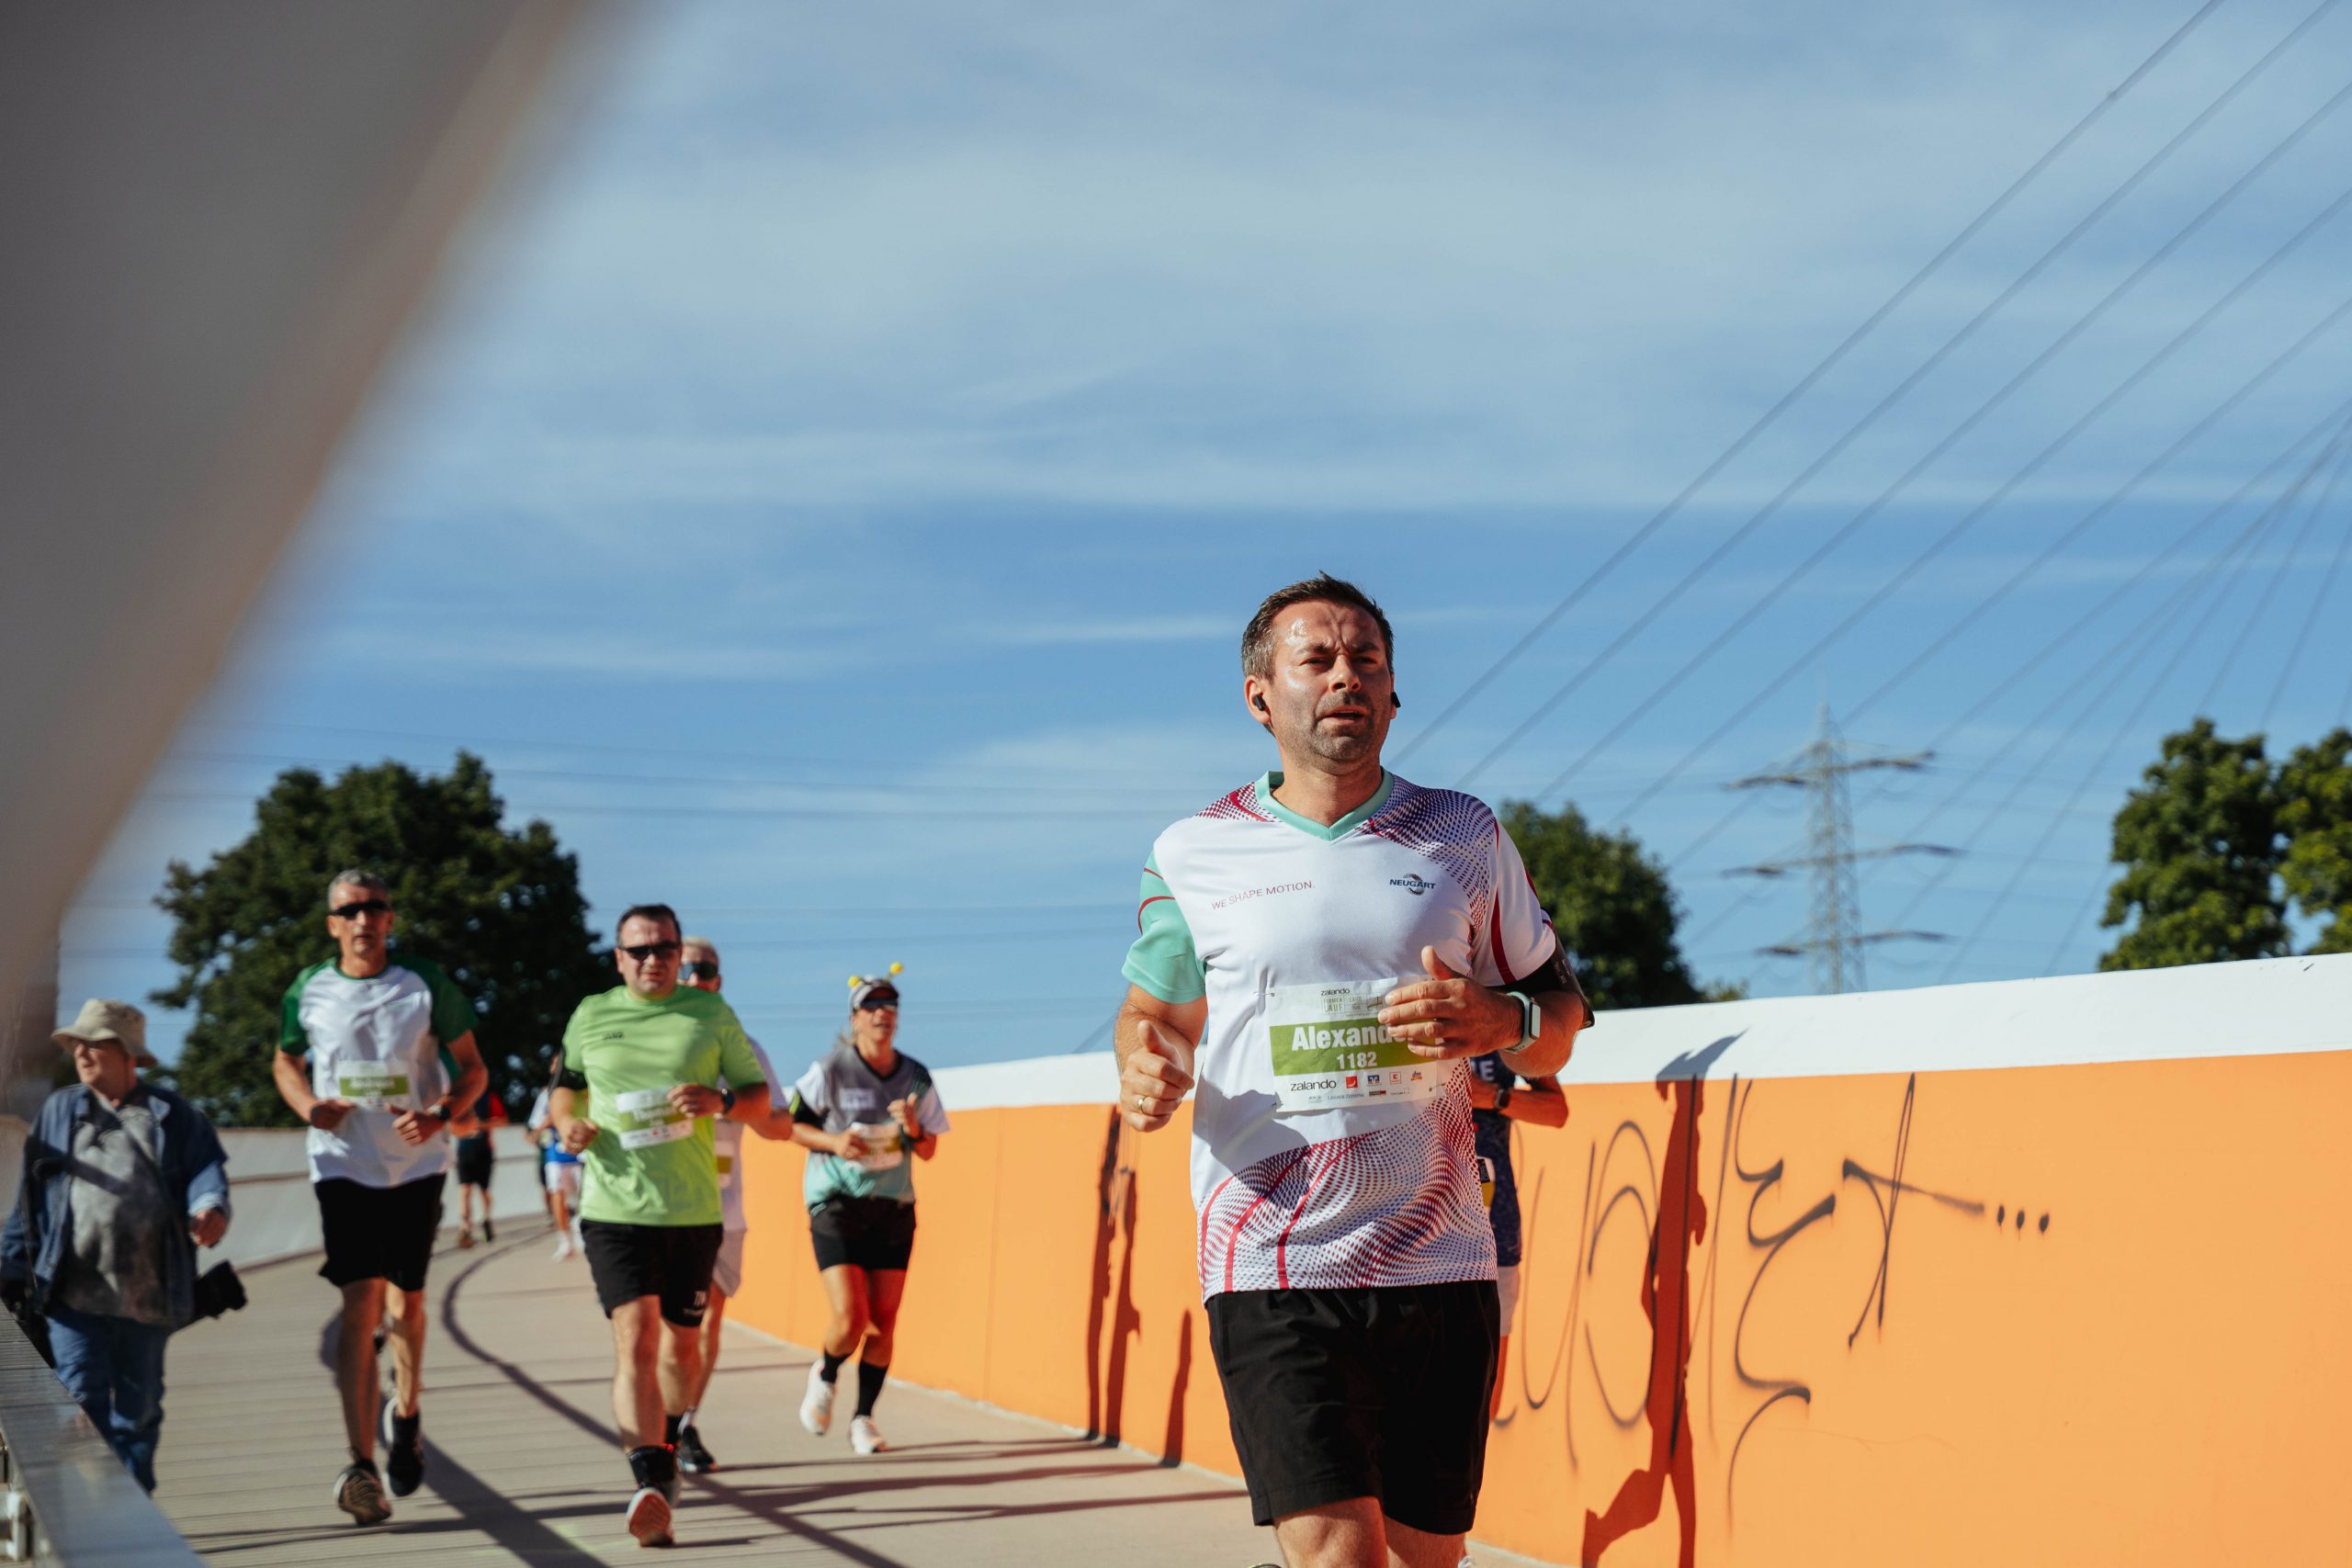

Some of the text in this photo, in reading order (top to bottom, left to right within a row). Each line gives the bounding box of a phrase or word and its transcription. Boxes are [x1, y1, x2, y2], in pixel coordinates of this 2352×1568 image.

[1389, 878, 1436, 889] NEUGART
[1212, 880, 1316, 910] WE SHAPE MOTION.
[1321, 987, 1351, 997] zalando
[1291, 1024, 1409, 1051] Alexand
[1337, 1051, 1377, 1069] 1182
[1291, 1078, 1337, 1091] zalando
